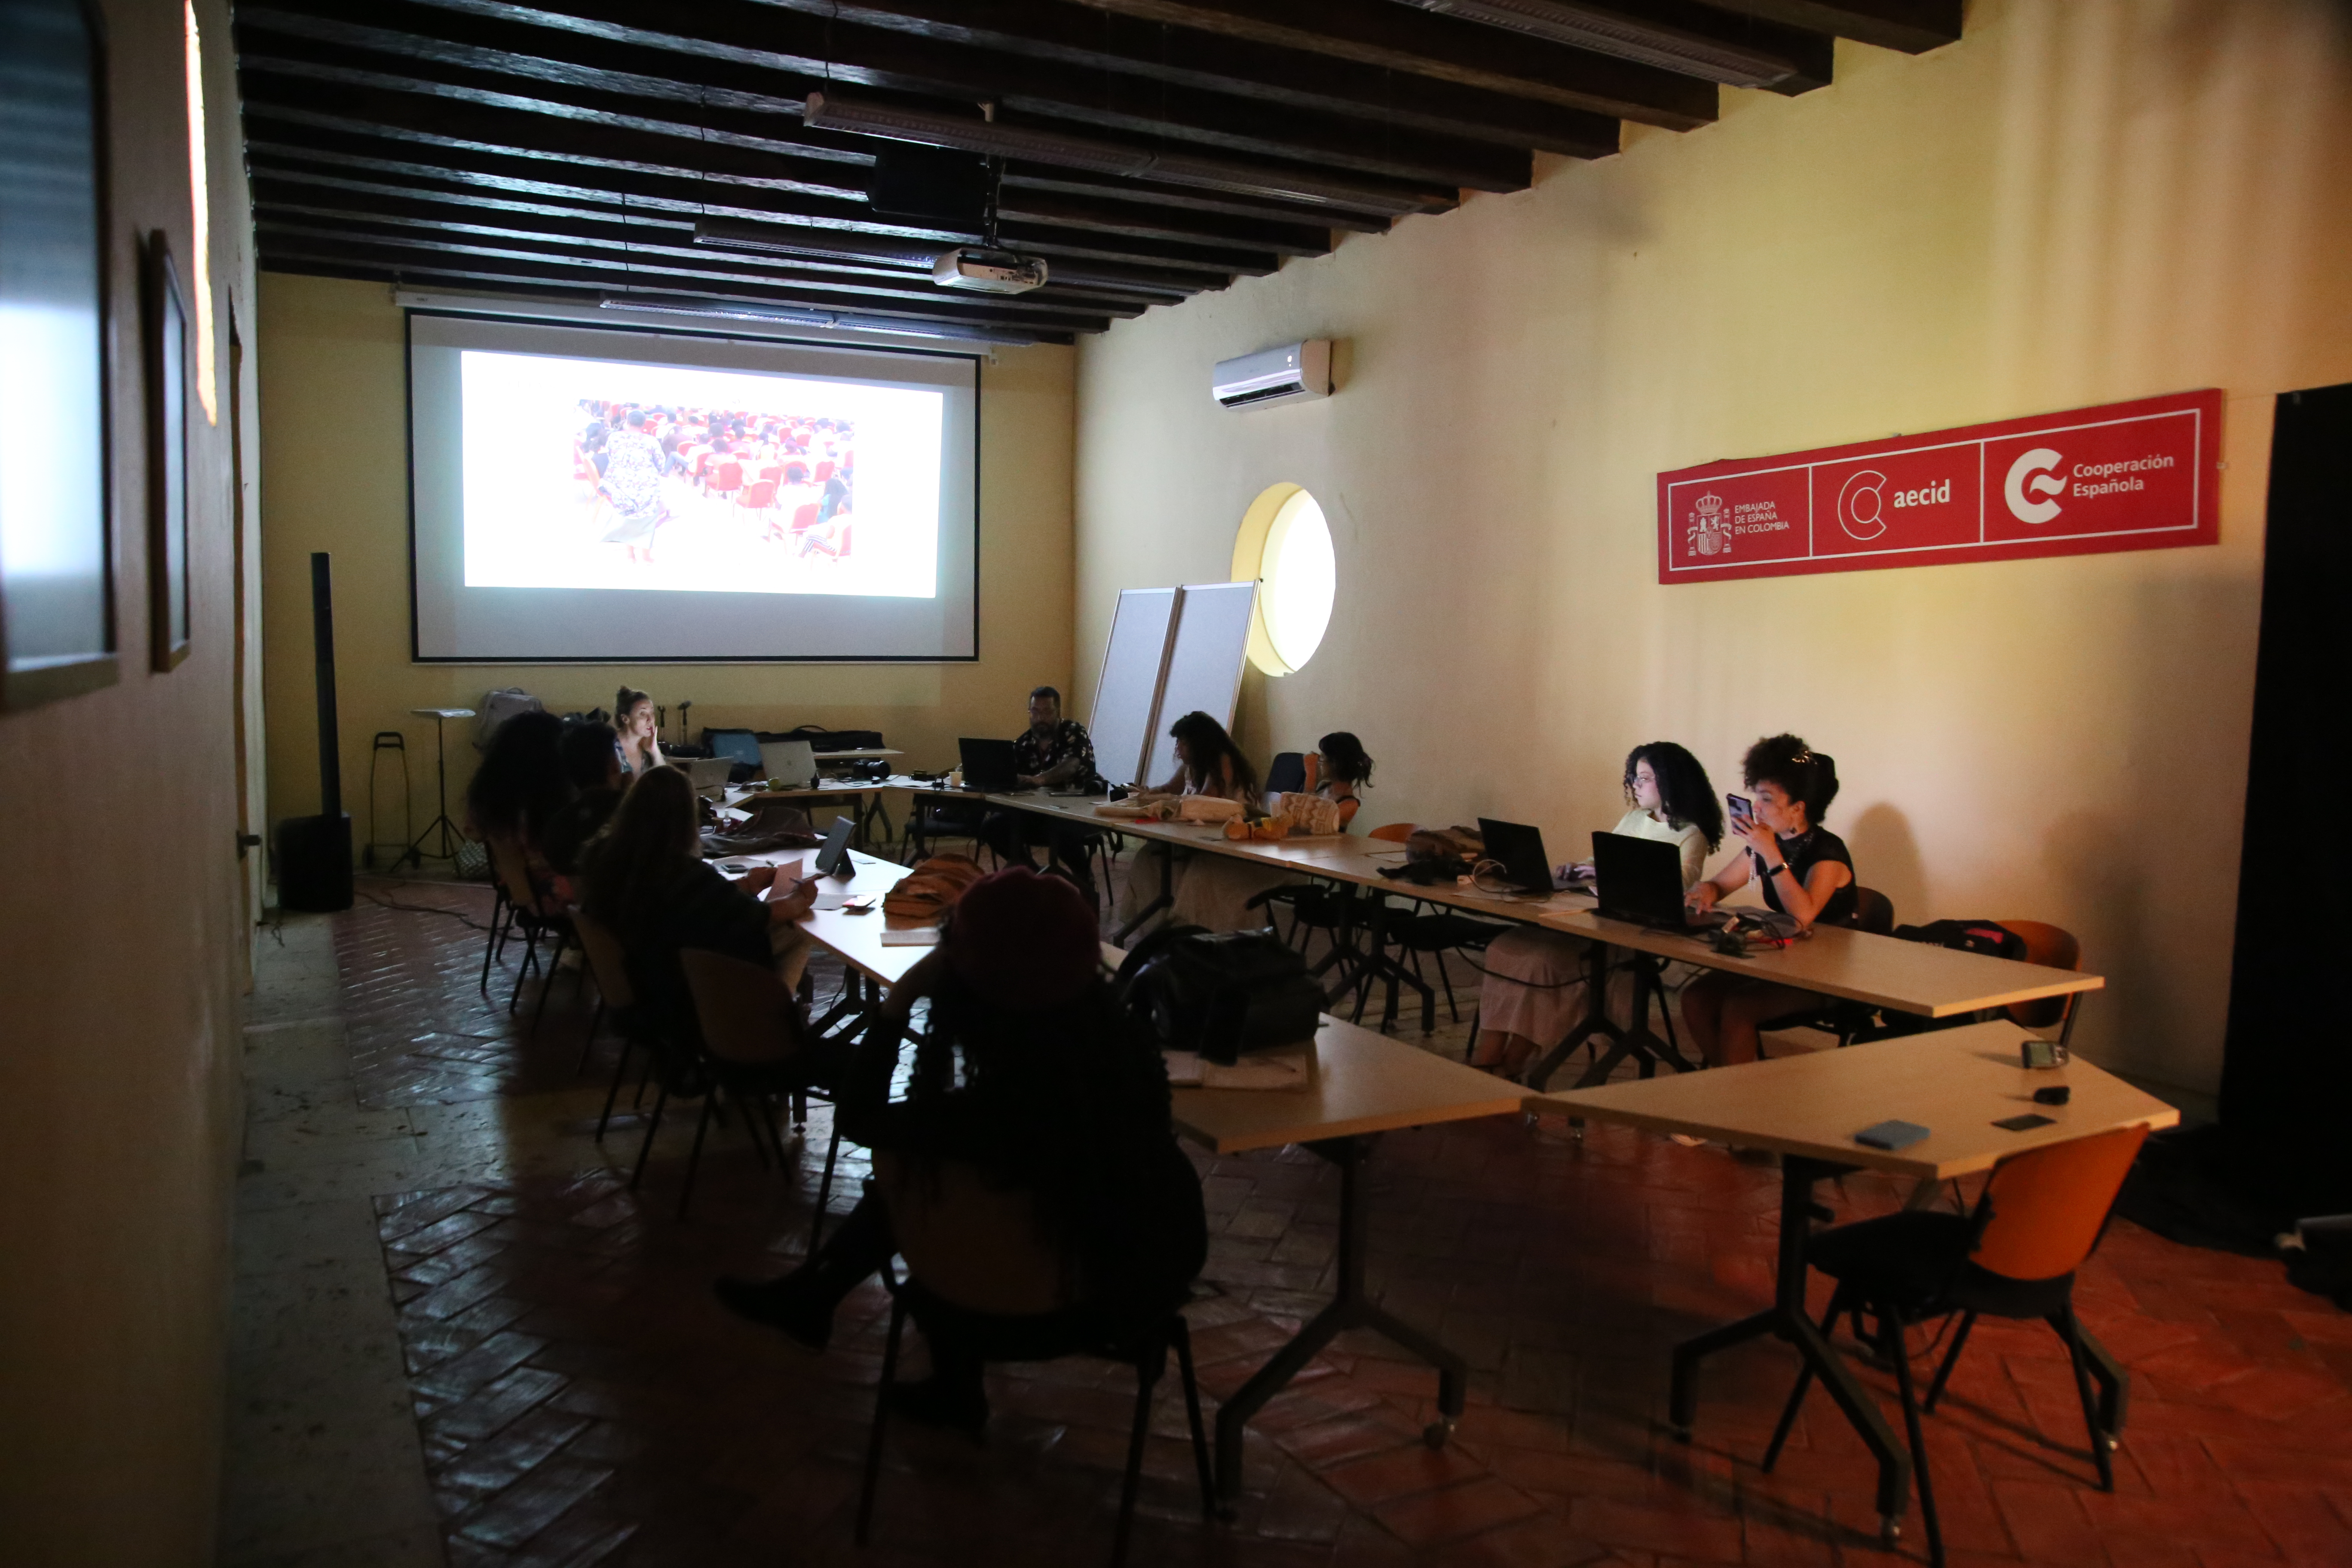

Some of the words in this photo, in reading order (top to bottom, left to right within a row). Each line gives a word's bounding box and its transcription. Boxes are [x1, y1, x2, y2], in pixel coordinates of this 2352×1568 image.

[2073, 453, 2174, 478] Cooperación
[1893, 478, 1950, 508] aecid
[2073, 476, 2144, 499] Española
[1734, 501, 1776, 514] EMBAJADA
[1734, 515, 1746, 524] DE
[1747, 510, 1778, 523] ESPAÑA
[1734, 526, 1746, 534] EN
[1747, 521, 1790, 533] COLOMBIA
